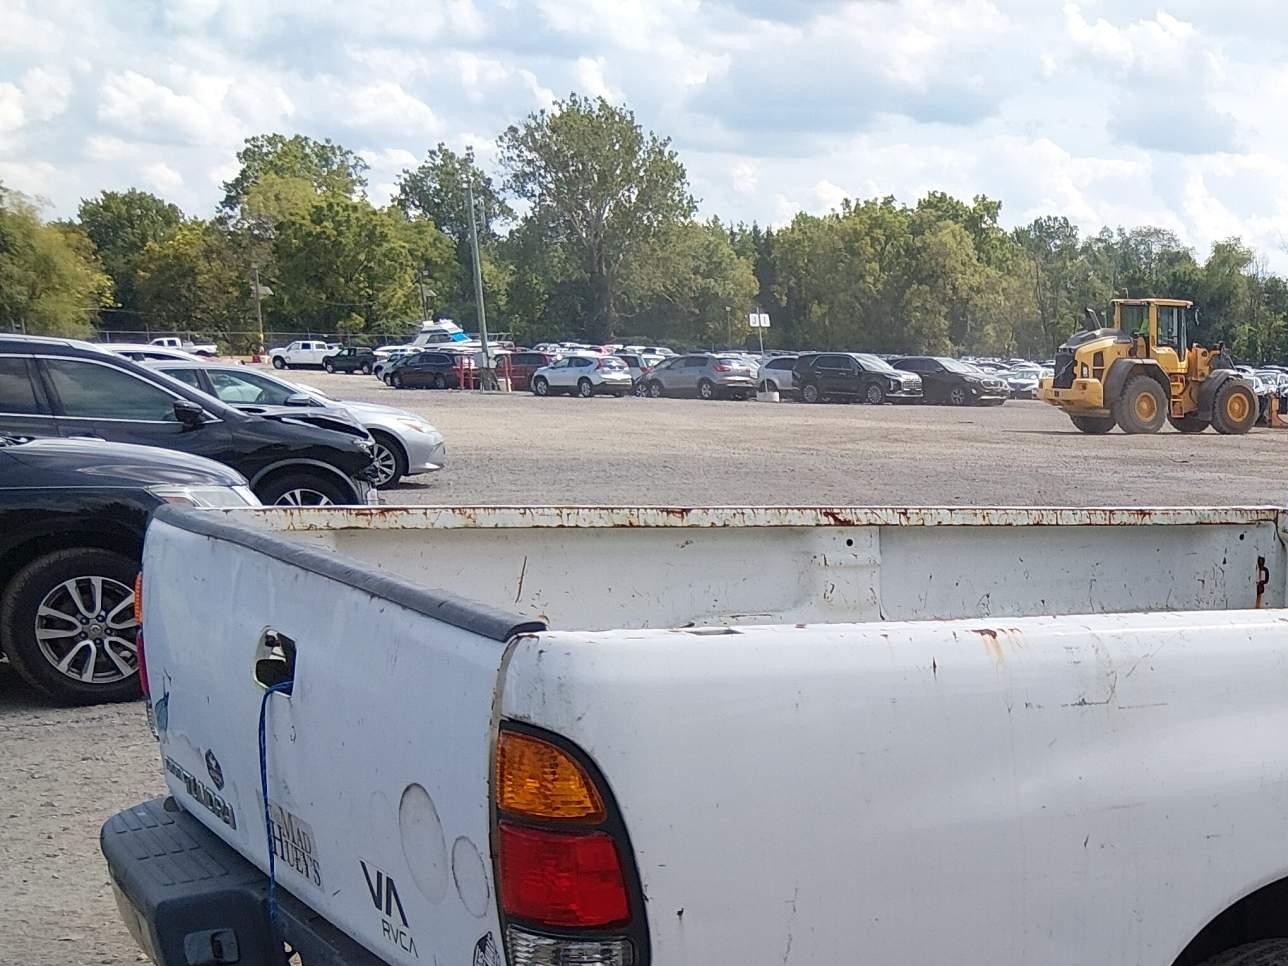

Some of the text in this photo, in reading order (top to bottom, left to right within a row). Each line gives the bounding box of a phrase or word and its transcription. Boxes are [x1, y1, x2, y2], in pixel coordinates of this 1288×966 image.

[183, 769, 236, 830] TUNDRA
[278, 805, 312, 855] MAD
[381, 917, 419, 959] RVCA
